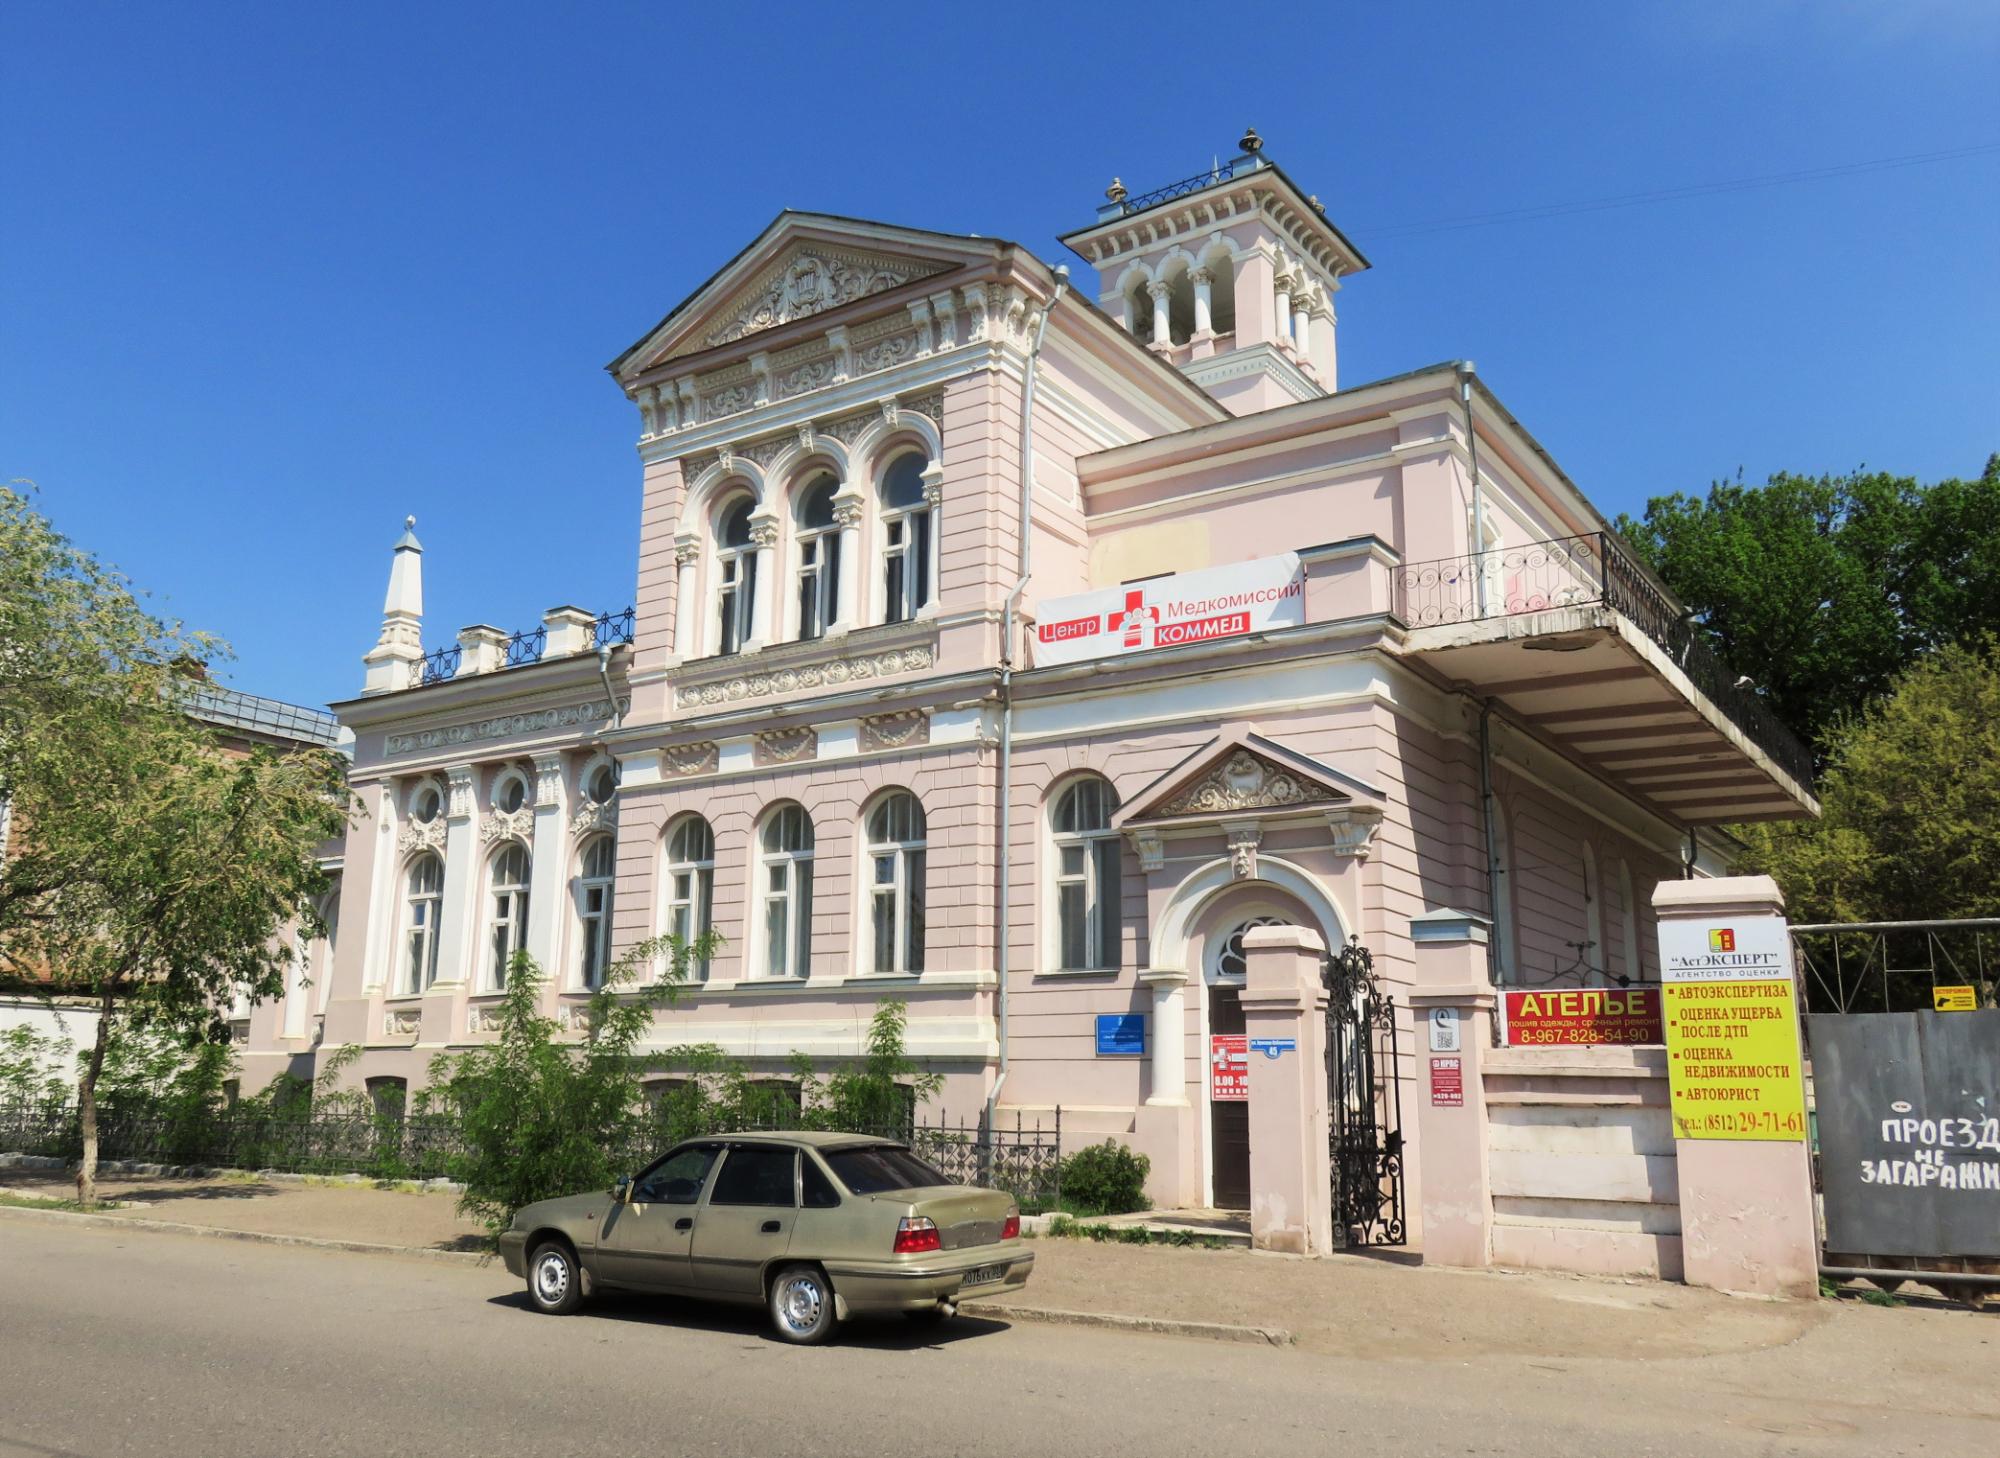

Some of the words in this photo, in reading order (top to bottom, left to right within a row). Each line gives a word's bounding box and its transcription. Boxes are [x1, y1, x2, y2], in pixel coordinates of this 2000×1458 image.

[1168, 580, 1301, 618] Медкомиссий
[1043, 617, 1097, 642] Центр
[1158, 615, 1244, 644] КОММЕД
[1675, 970, 1732, 978] АГЕНТСТВО
[1738, 969, 1780, 977] ОЦЕНКИ
[1678, 985, 1788, 999] АВТОЭКСПЕРТИЗА
[1519, 991, 1647, 1017] АТЕЛЬЕ
[1680, 1008, 1730, 1022] ОЦЕНКА
[1731, 1007, 1782, 1021] УЩЕРБА
[1509, 1019, 1538, 1028] пошив
[1581, 1018, 1622, 1028] срочный
[1625, 1018, 1660, 1027] ремонт
[1521, 1028, 1649, 1043] 8-967-828-54-90
[1681, 1025, 1722, 1038] ПОСЛЕ
[1724, 1025, 1748, 1040] ДТП
[1683, 1048, 1733, 1062] ОЦЕНКА
[1684, 1065, 1790, 1080] НЕДВИЖИМОСТИ
[1686, 1088, 1760, 1100] АВТОЮРИСТ
[1704, 1114, 1737, 1133] (8512)
[1739, 1112, 1804, 1132] 29-71-61
[1882, 1118, 2000, 1152] ПРОЕЗД
[1914, 1150, 1945, 1166] НЕ
